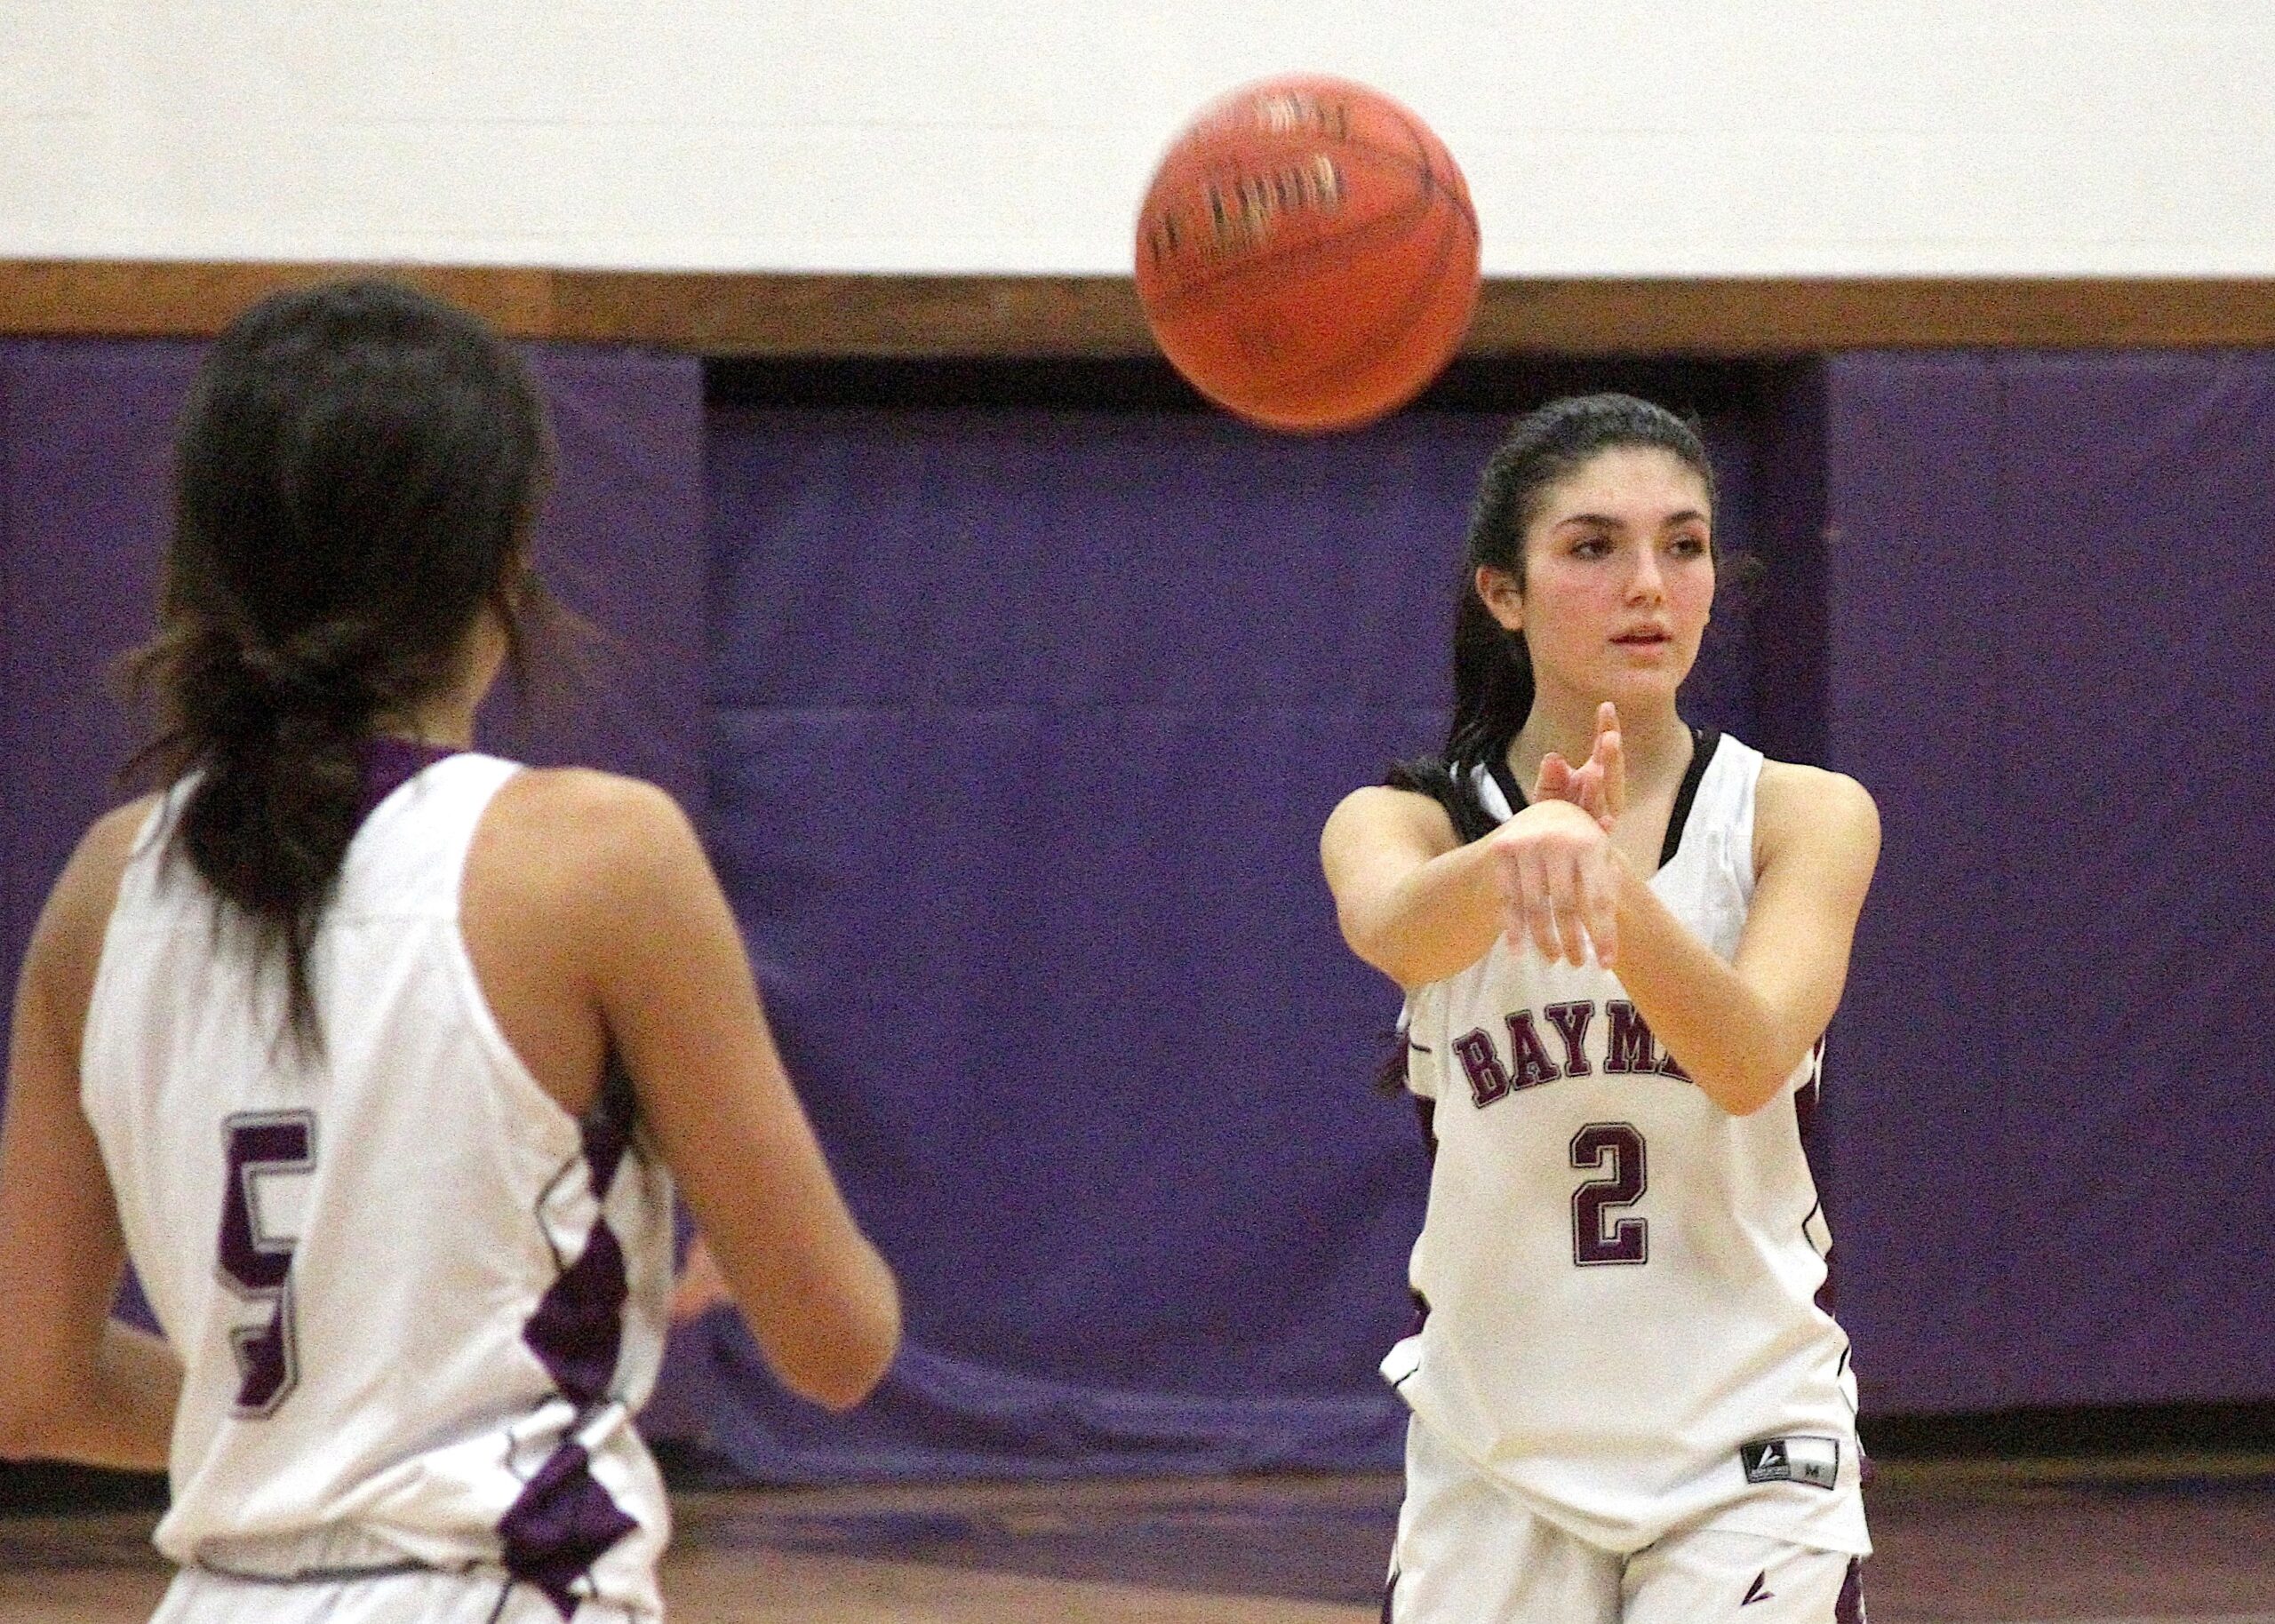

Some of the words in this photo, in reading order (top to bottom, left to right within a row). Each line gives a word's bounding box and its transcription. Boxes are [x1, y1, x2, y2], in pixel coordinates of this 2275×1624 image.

[1452, 999, 1693, 1109] BAYM
[1569, 1121, 1648, 1267] 2
[214, 1108, 317, 1421] 5
[1804, 1461, 1820, 1477] M
